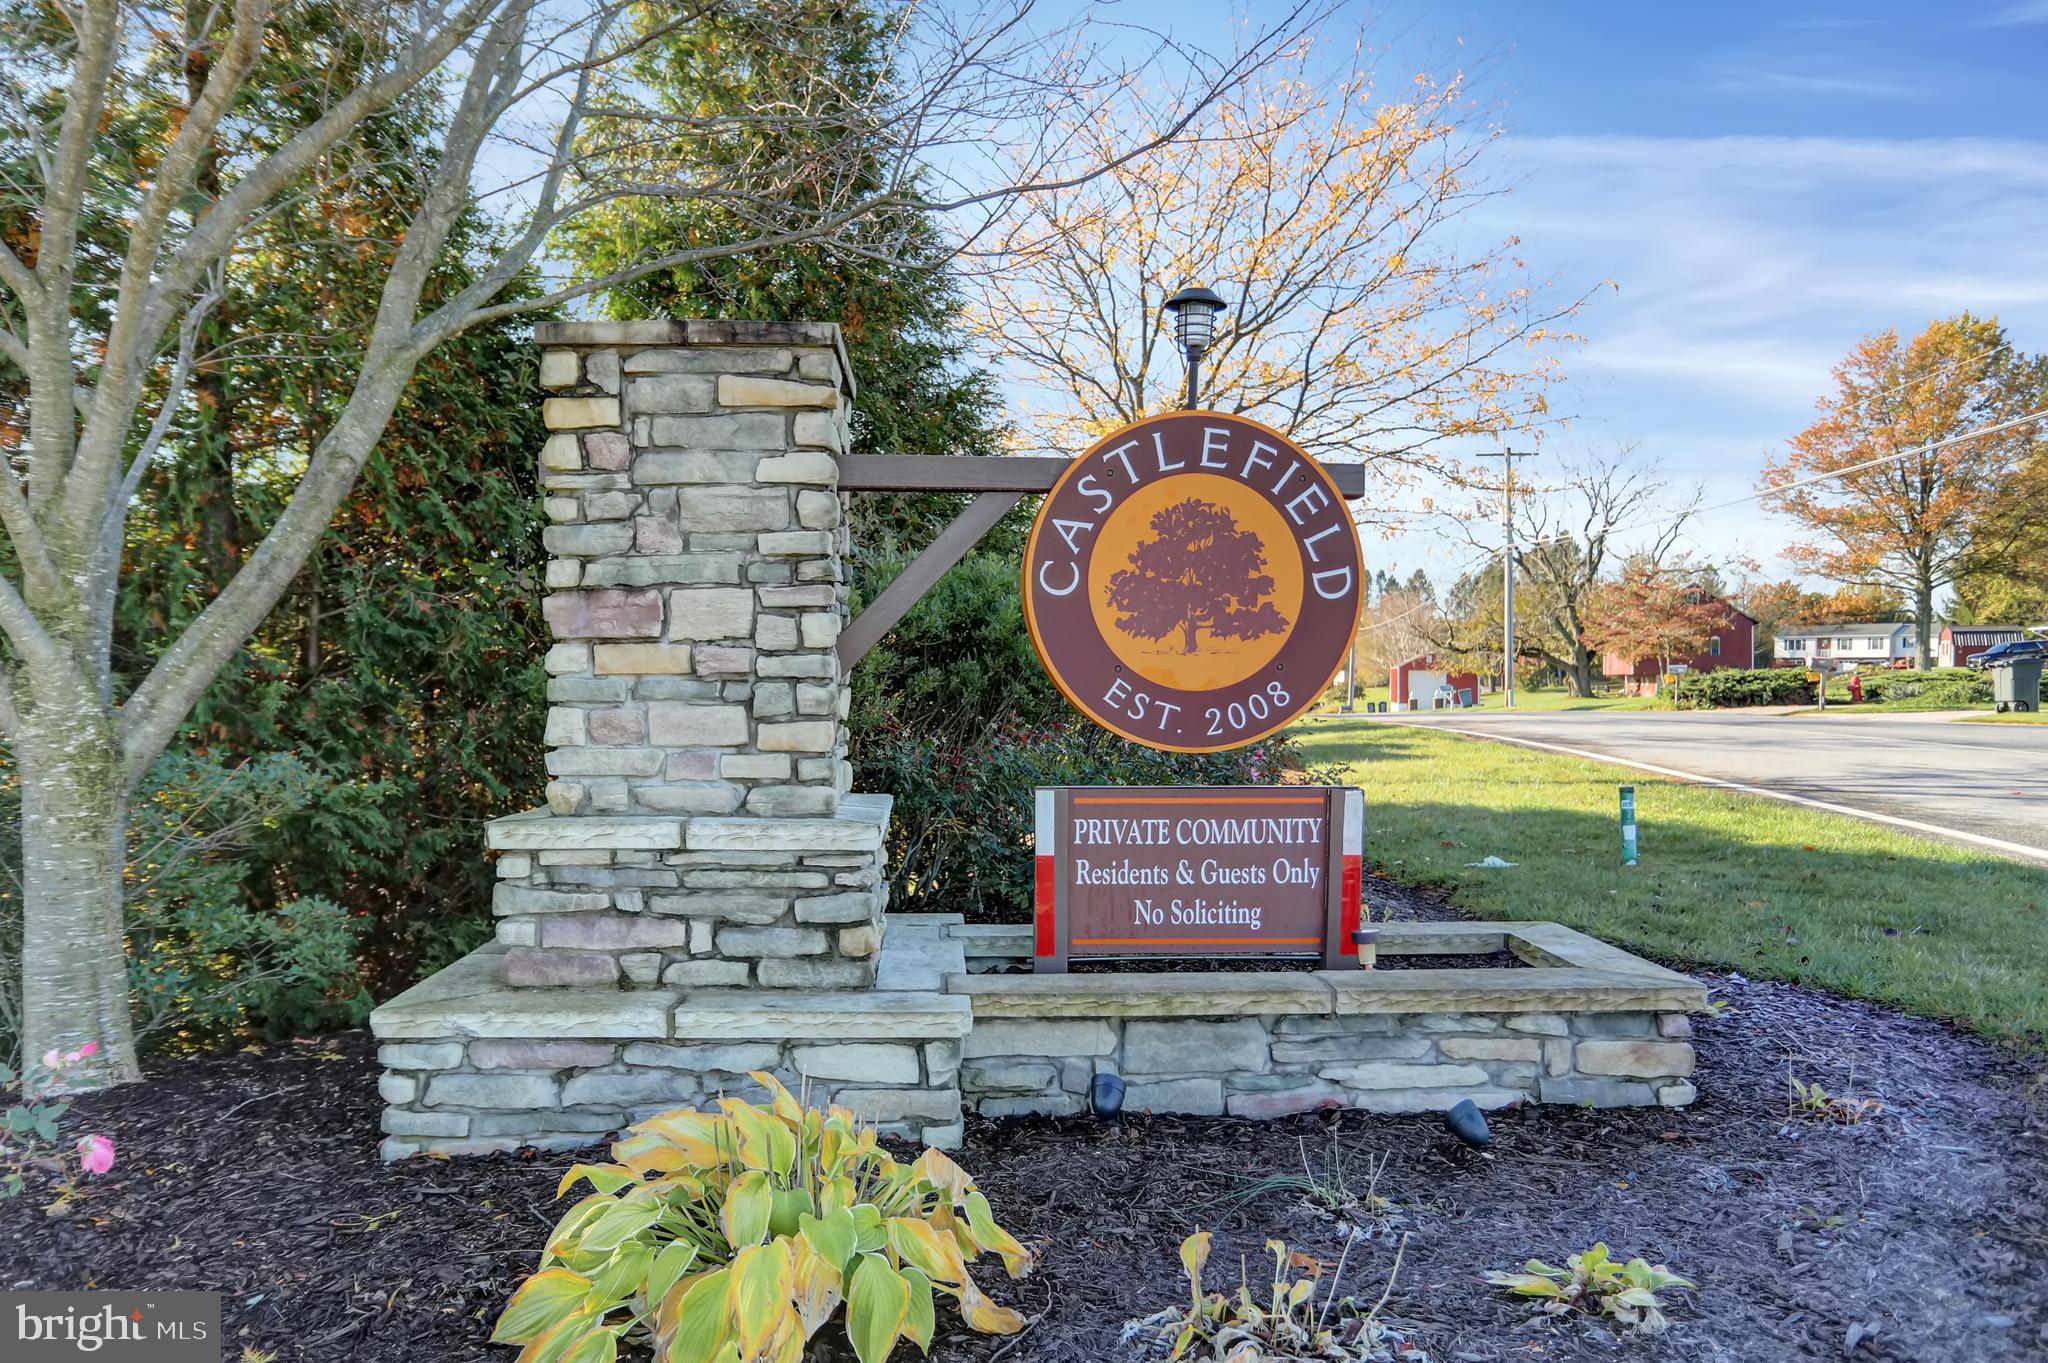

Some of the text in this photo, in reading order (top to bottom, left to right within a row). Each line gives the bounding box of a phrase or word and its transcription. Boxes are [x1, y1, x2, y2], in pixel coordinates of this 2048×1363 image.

[1039, 427, 1352, 600] CASTLEFIELD
[1102, 677, 1291, 736] EST. 2008
[1073, 818, 1322, 845] PRIVATE COMMUNITY
[1075, 858, 1320, 889] Residents & Guests Only
[1134, 899, 1262, 930] No Soliciting
